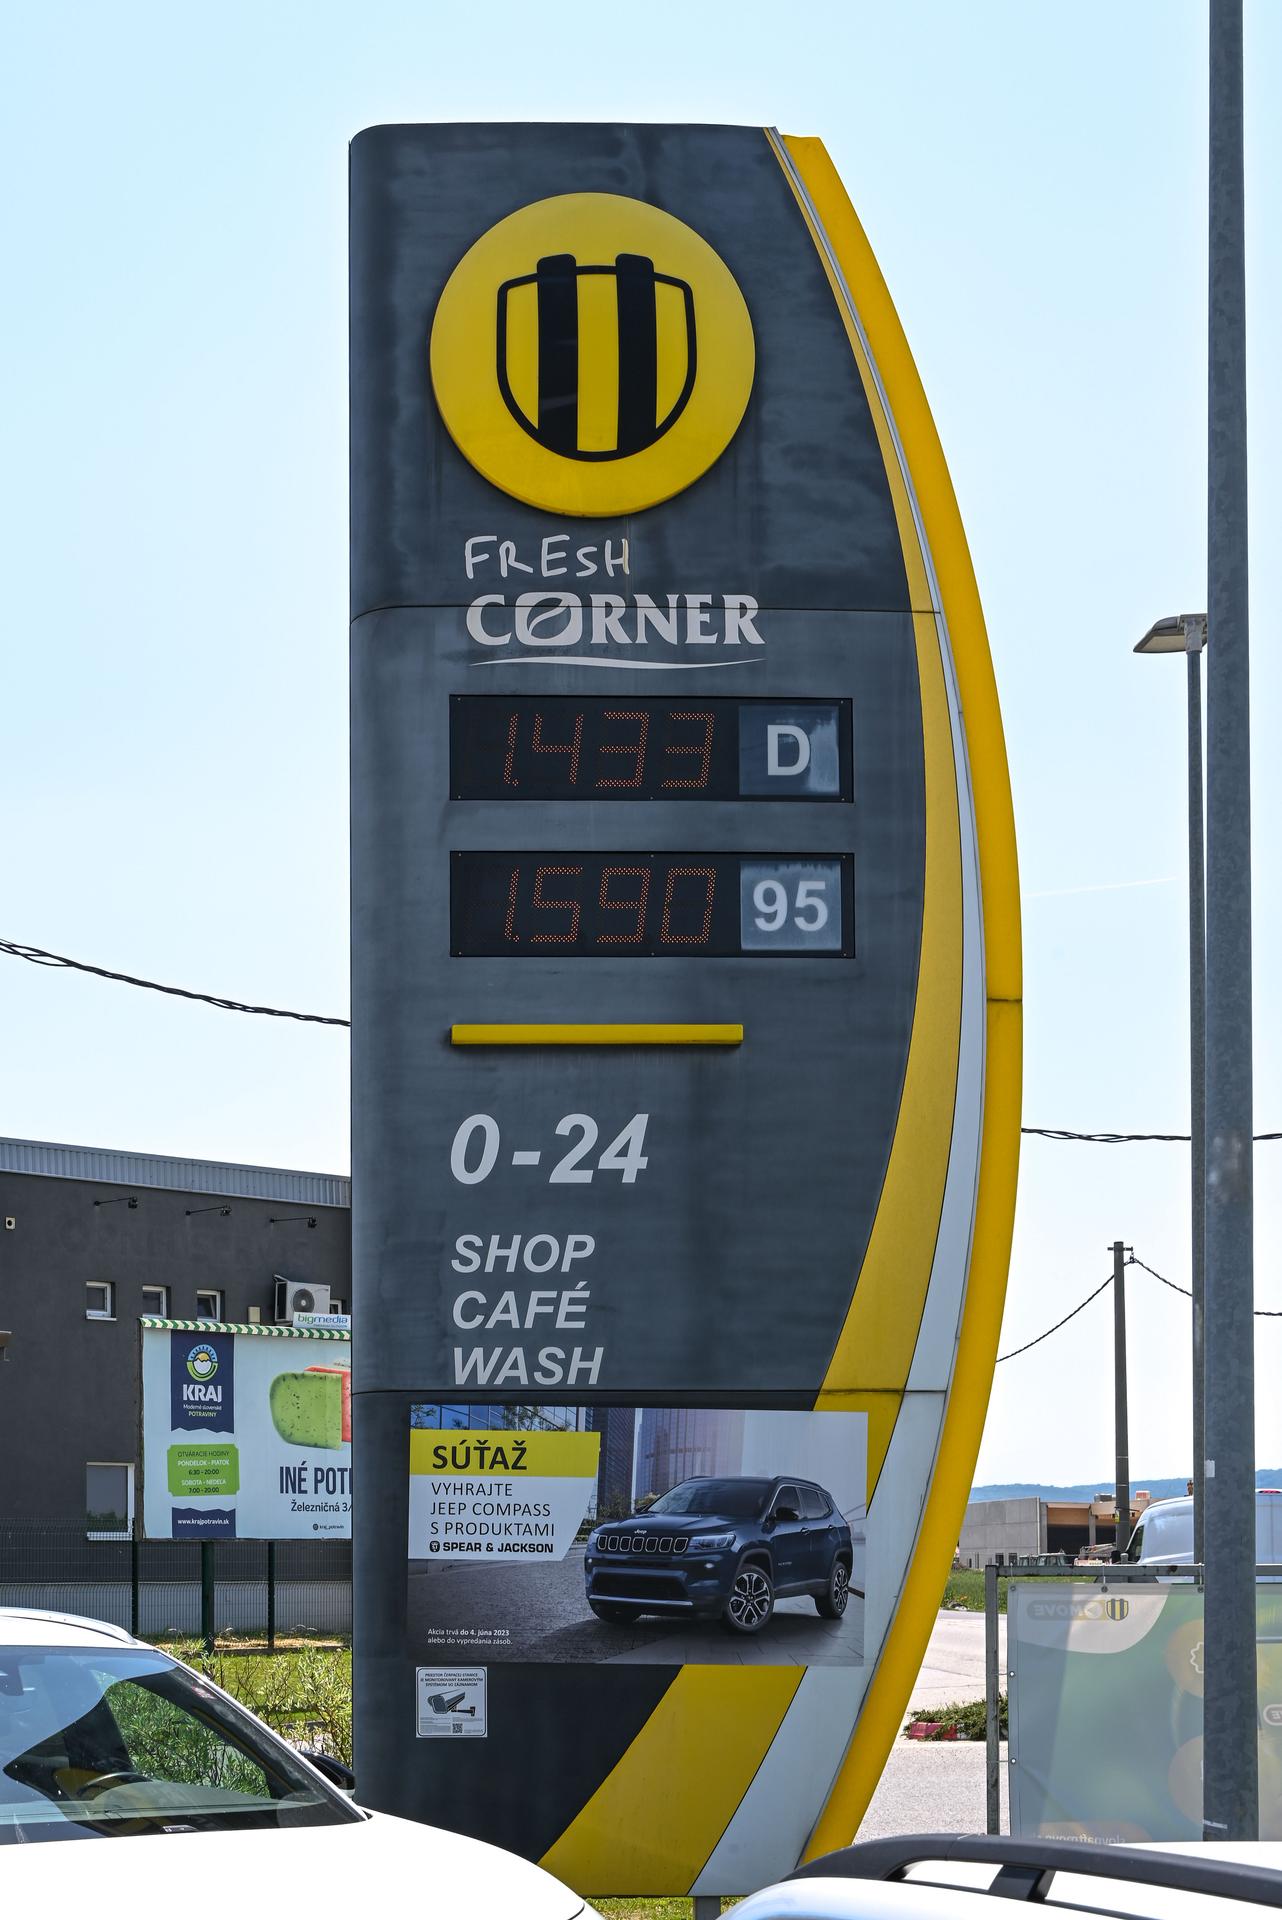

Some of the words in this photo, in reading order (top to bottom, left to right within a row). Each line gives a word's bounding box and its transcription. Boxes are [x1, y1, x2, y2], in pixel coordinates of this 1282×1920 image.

[465, 535, 630, 579] FRESH
[466, 592, 766, 646] CORNER
[767, 724, 811, 776] D
[752, 880, 829, 932] 95
[451, 1234, 596, 1273] SHOP
[452, 1281, 591, 1329] CAFÉ
[298, 1314, 348, 1324] bigmedia
[453, 1346, 604, 1386] WASH
[182, 1384, 222, 1403] KRAJ
[177, 1459, 207, 1467] PONDELOK
[432, 1439, 527, 1470] SÚŤAŽ
[280, 1460, 308, 1494] INÉ
[431, 1482, 513, 1496] VYHRAJTE
[291, 1499, 340, 1512] Železničná
[430, 1502, 467, 1515] JEEP
[472, 1502, 551, 1517] COMPASS
[430, 1521, 439, 1535] S
[445, 1522, 555, 1537] PRODUKTAMI
[443, 1542, 482, 1552] SPEAR
[486, 1542, 494, 1552] &
[498, 1543, 554, 1553] JACKSON
[446, 1628, 459, 1636] trvá
[456, 1637, 492, 1645] vypredania
